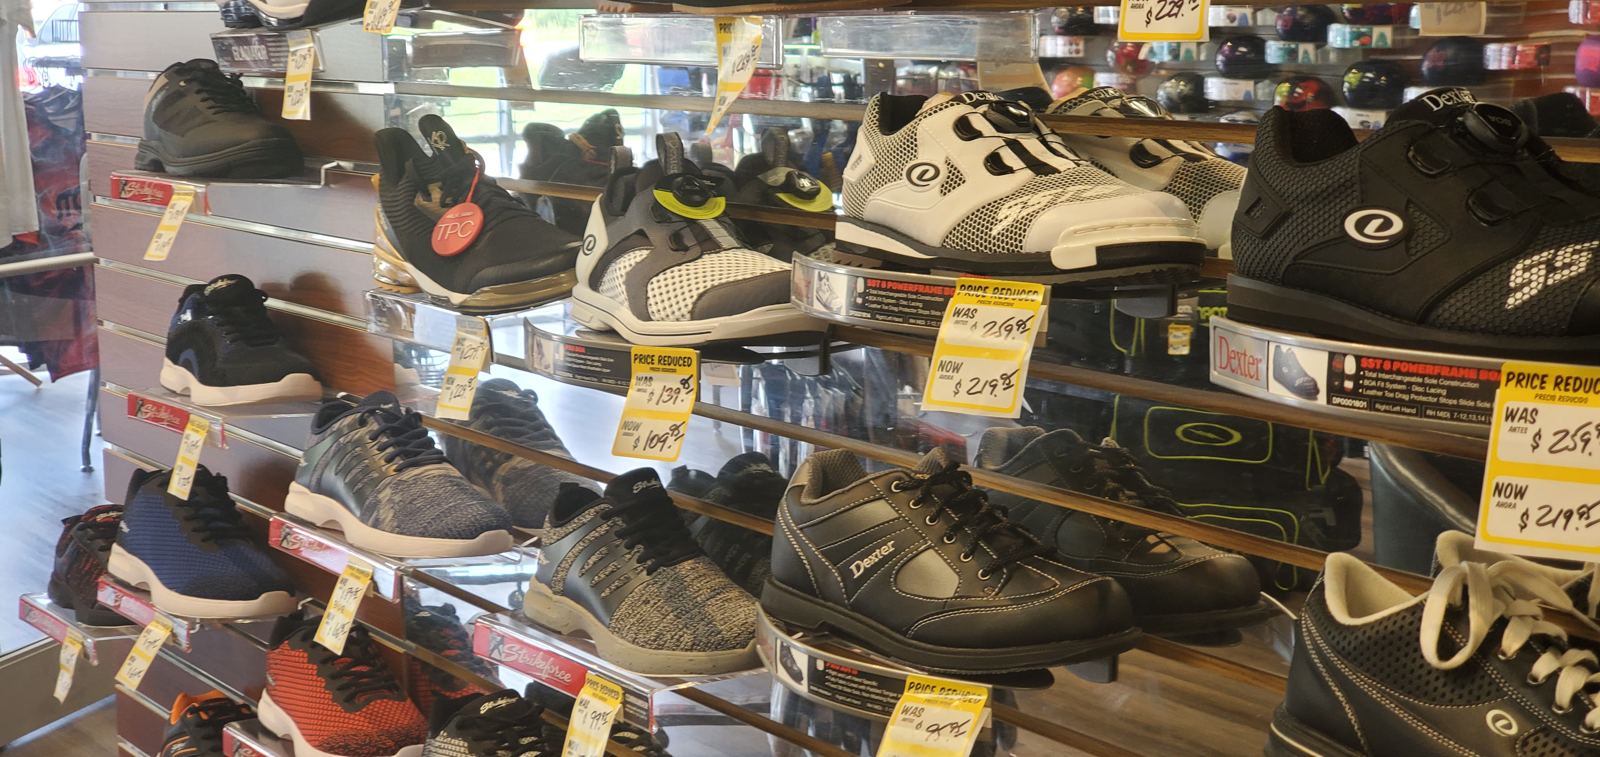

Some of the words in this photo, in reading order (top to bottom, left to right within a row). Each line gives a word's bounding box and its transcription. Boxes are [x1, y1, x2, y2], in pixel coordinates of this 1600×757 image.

[437, 221, 475, 241] TPC
[957, 283, 990, 298] PRICE
[990, 286, 1040, 303] REDUCED
[953, 306, 978, 320] WAS
[633, 353, 656, 366] PRICE
[657, 355, 693, 368] REDUCED
[937, 359, 964, 375] NOW
[1218, 335, 1263, 382] Dexter
[1360, 357, 1383, 369] SST
[1393, 360, 1478, 380] POWERFRAME
[1479, 369, 1501, 382] BO
[1385, 381, 1407, 391] System
[1426, 386, 1448, 397] Lacing
[1438, 378, 1480, 389] Construction
[1504, 371, 1549, 391] PRICE
[1504, 406, 1539, 425] WAS
[621, 420, 642, 433] NOW
[1530, 428, 1542, 453] $
[1492, 481, 1529, 501] NOW
[1495, 501, 1518, 510] AHORA
[1518, 507, 1530, 534] $
[849, 540, 896, 580] Dexter
[501, 643, 572, 684] Strikeforce
[900, 704, 926, 718] WAS
